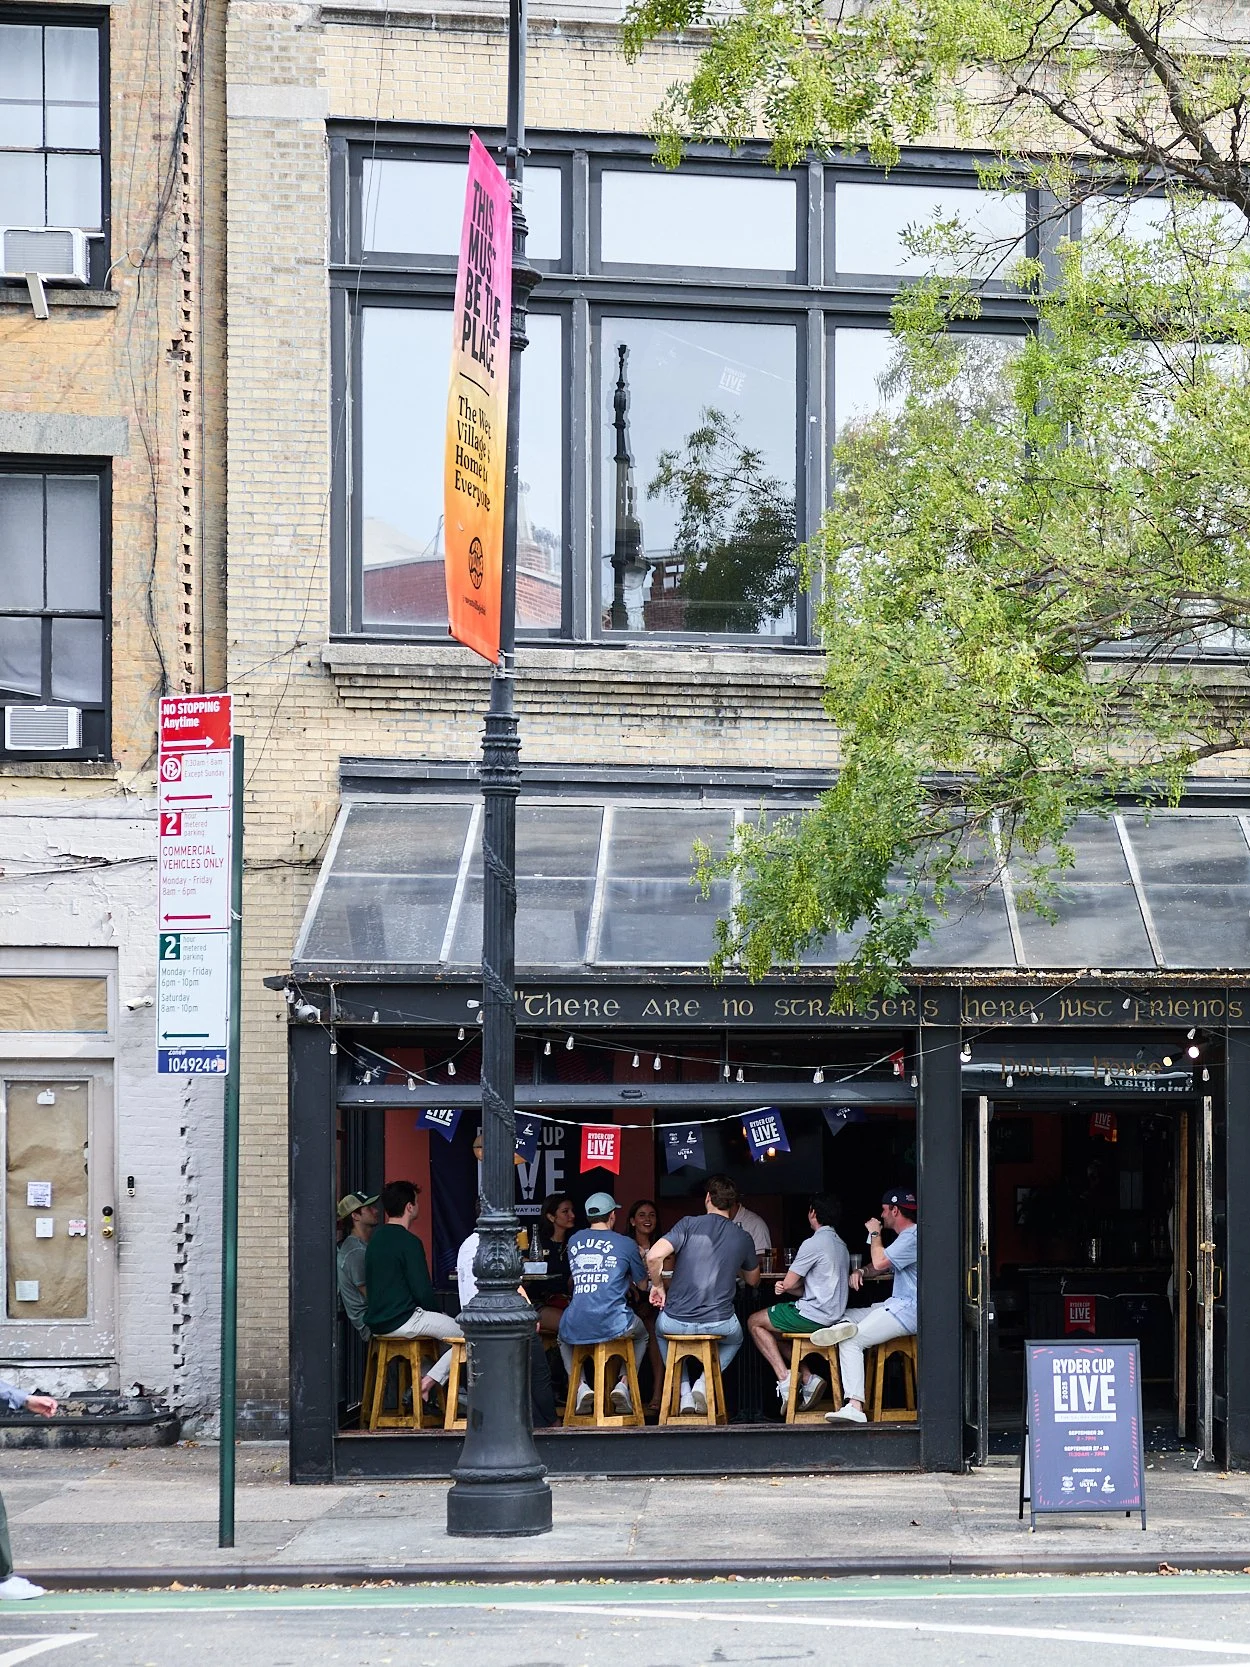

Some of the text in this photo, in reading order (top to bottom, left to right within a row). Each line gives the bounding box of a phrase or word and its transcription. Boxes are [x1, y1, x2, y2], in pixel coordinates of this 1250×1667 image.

[472, 179, 494, 241] THIS
[464, 266, 482, 318] BE
[458, 395, 477, 424] The
[456, 444, 482, 479] Home
[163, 701, 220, 715] NO STOPPING
[163, 716, 200, 730] Anytime
[165, 813, 177, 835] 2
[184, 829, 205, 837] parking
[162, 845, 216, 857] COMMERCIAL
[163, 858, 224, 870] VEHICLES ONLY
[162, 876, 187, 885] Monday
[193, 876, 213, 885] Friday
[164, 935, 176, 958] 2
[182, 944, 207, 952] metered
[182, 952, 204, 962] parking
[161, 967, 186, 977] Monday
[192, 966, 213, 977] Friday
[161, 979, 176, 988] 6pm
[182, 977, 199, 988] 10pm
[161, 993, 190, 1004] Saturday
[161, 1004, 175, 1013] 8am
[181, 1003, 199, 1014] 10pm
[168, 1057, 211, 1073] 104924
[749, 1116, 775, 1129] RYDER CUP
[1094, 1113, 1111, 1127] LIVE
[751, 1123, 779, 1143] LIVE
[588, 1140, 614, 1155] LIVE
[570, 1239, 614, 1256] BLUE'S
[574, 1274, 609, 1285] TCHER
[574, 1284, 598, 1295] SHOP
[1070, 1308, 1090, 1319] LIVE
[1053, 1358, 1115, 1374] RYDER CUP
[1053, 1375, 1117, 1411] LIVE
